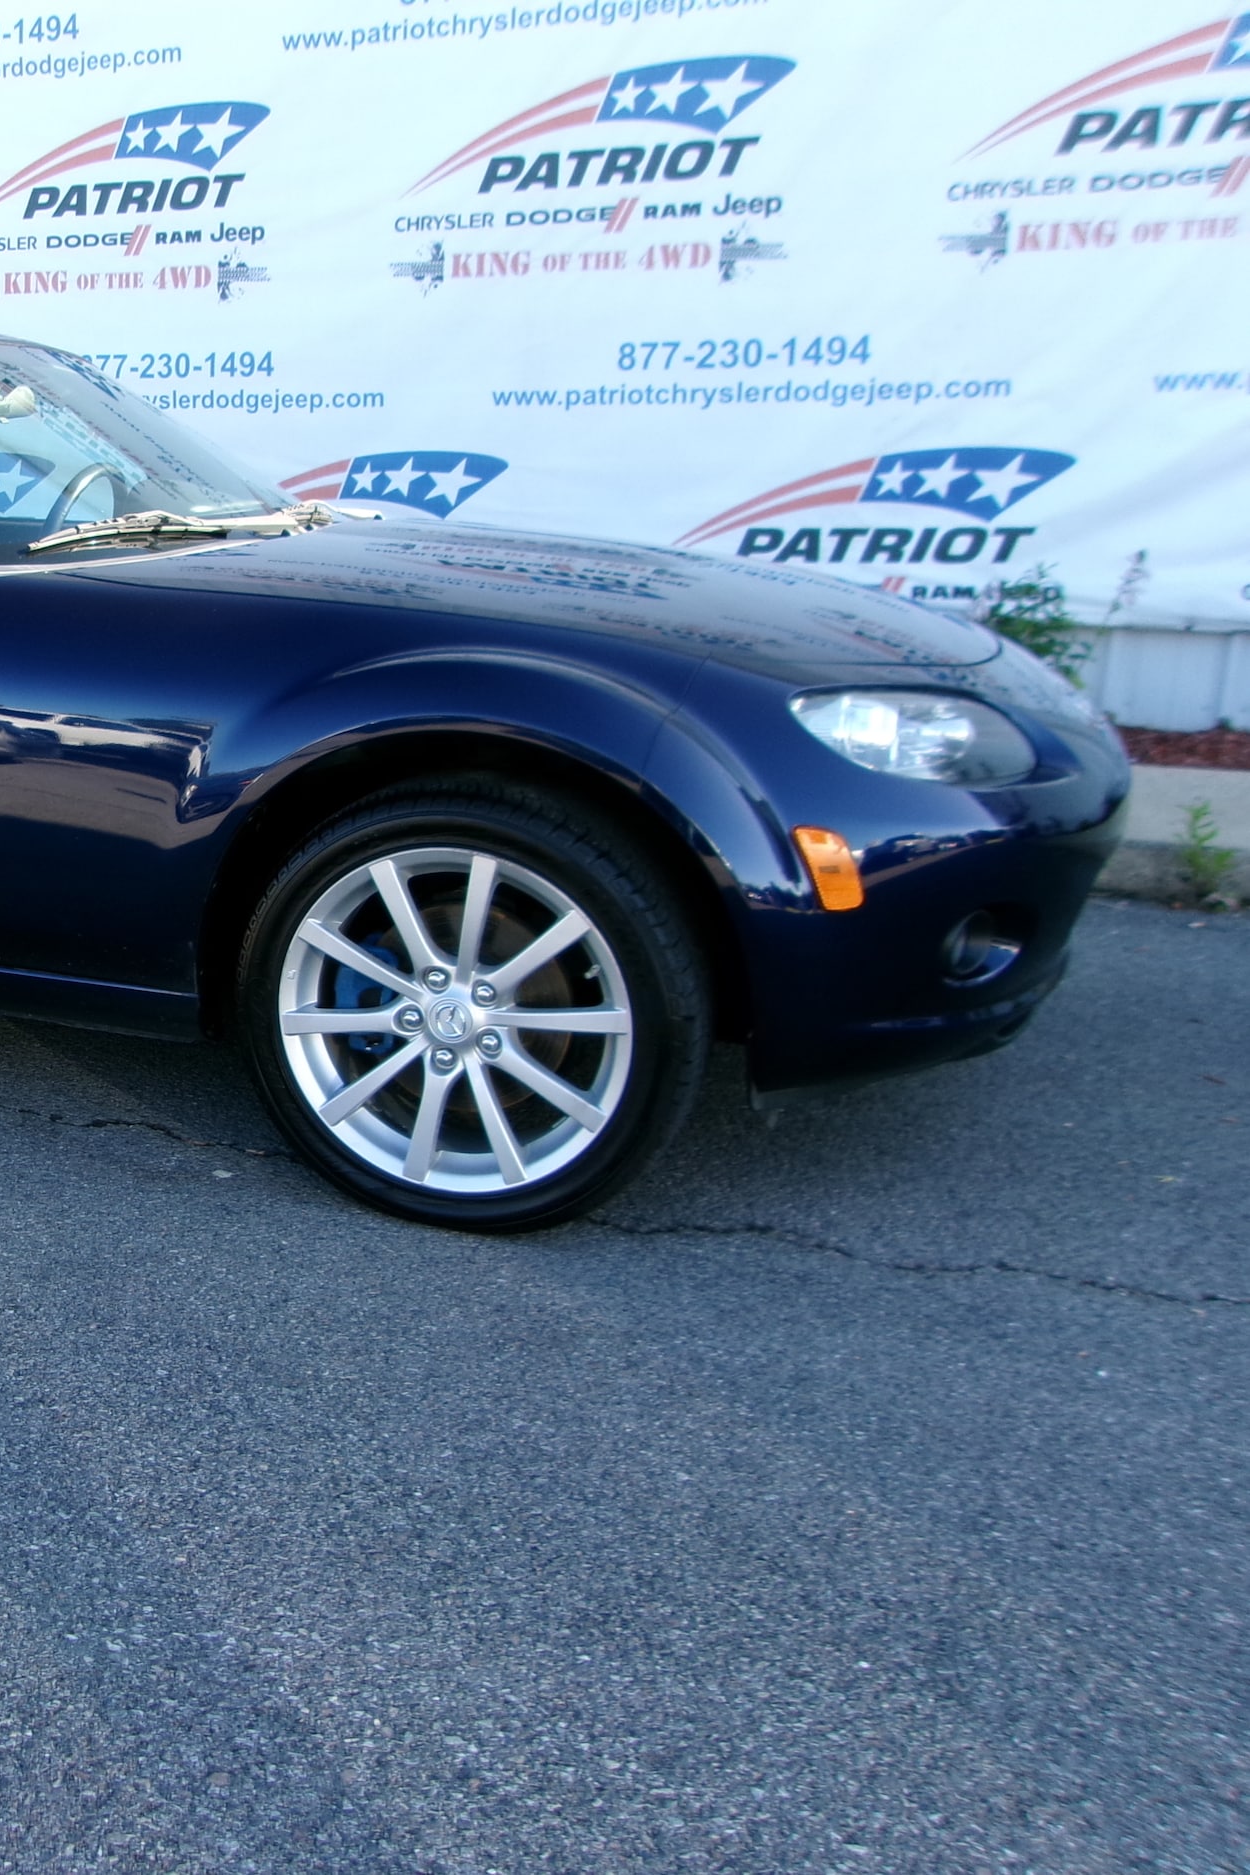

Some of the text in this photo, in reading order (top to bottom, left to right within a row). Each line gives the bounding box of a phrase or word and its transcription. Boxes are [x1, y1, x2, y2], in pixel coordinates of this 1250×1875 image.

[478, 136, 761, 194] PATRIOT
[947, 164, 1231, 201] CHRYSLER DODGE
[23, 173, 246, 219] PATRIOT
[395, 193, 783, 233] CHRYSLER DODGE RAM Jeep
[46, 232, 134, 249] DODGE
[155, 229, 201, 245] RAM
[210, 222, 265, 245] Jeep
[1016, 215, 1239, 252] KING OF THE
[451, 242, 712, 278] KING OF THE 4WD
[4, 265, 212, 295] KING OF THE 4WD
[617, 334, 872, 371] 877-230-1494
[492, 378, 1012, 411] www.patriotchryslerdodgejeep.com
[737, 526, 1036, 563] PATRIOT
[911, 586, 976, 599] RAM
